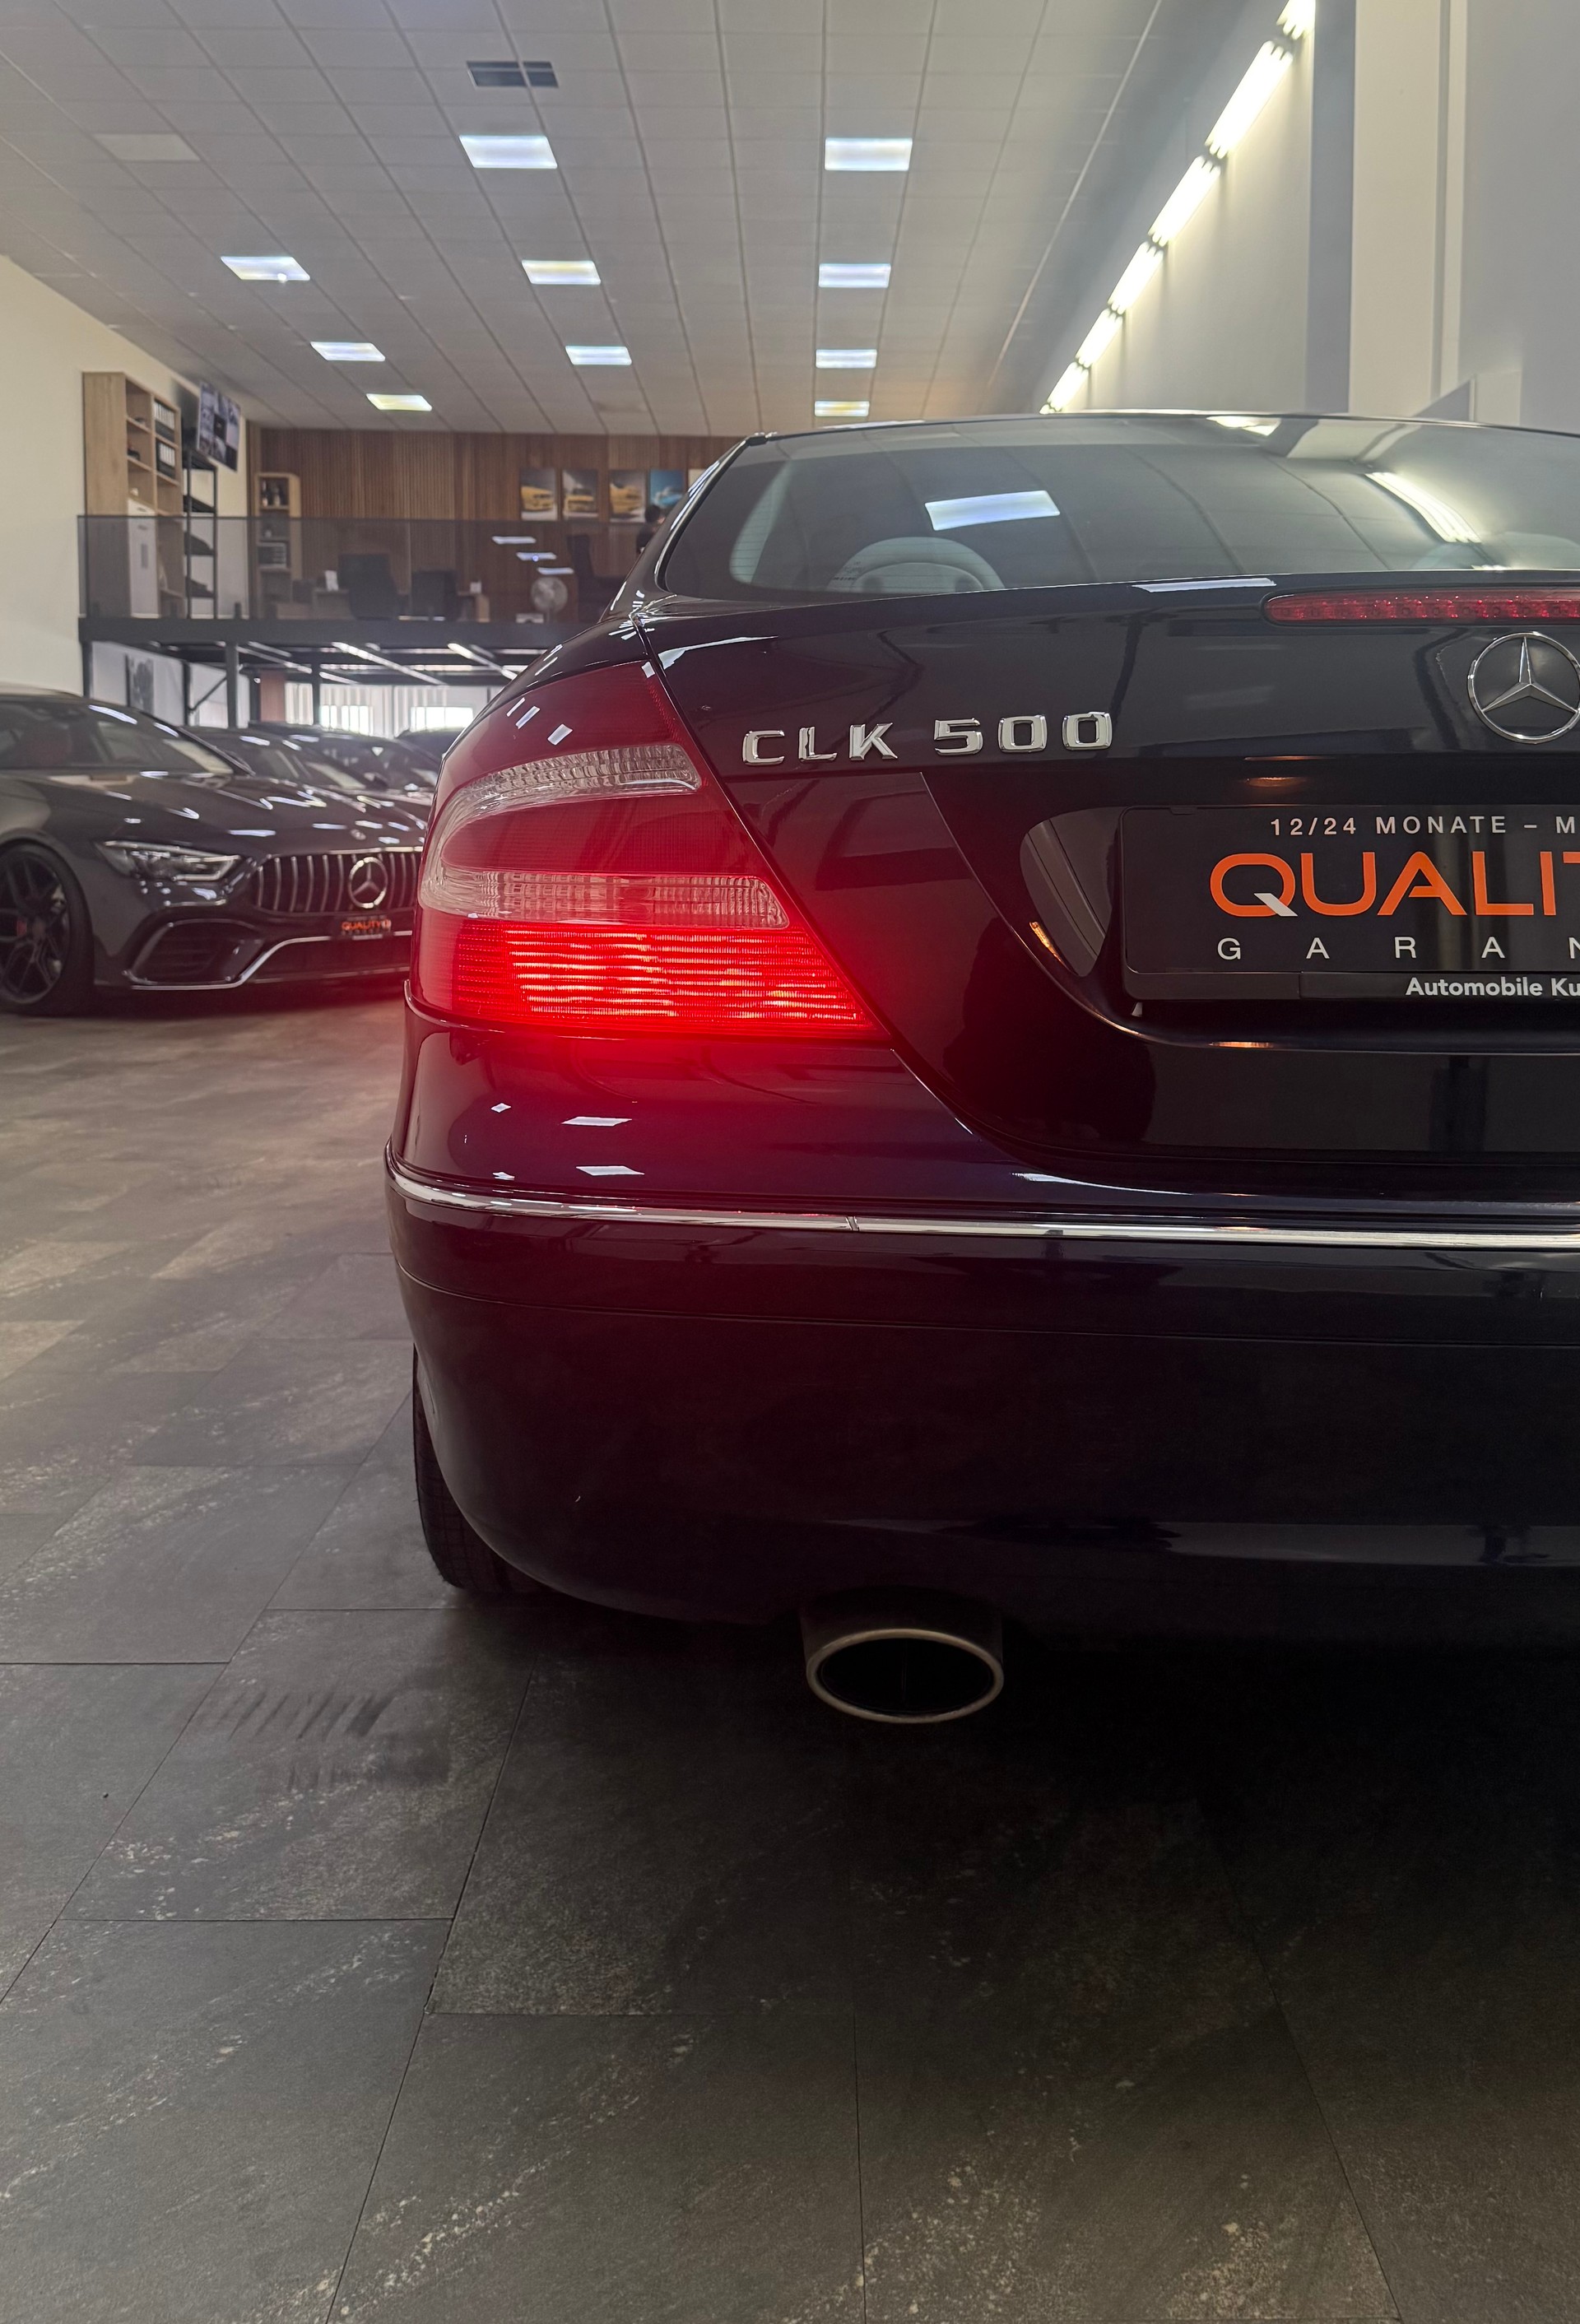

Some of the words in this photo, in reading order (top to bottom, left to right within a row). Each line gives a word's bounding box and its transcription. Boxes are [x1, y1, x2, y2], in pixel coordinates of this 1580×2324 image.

[742, 723, 899, 766] CLK
[934, 711, 1113, 756] 500
[1271, 817, 1357, 836] 12/24
[1375, 816, 1507, 834] MONATE
[1210, 851, 1580, 917] QUALI
[1405, 976, 1543, 997] Automobile
[1550, 978, 1580, 997] Ku
